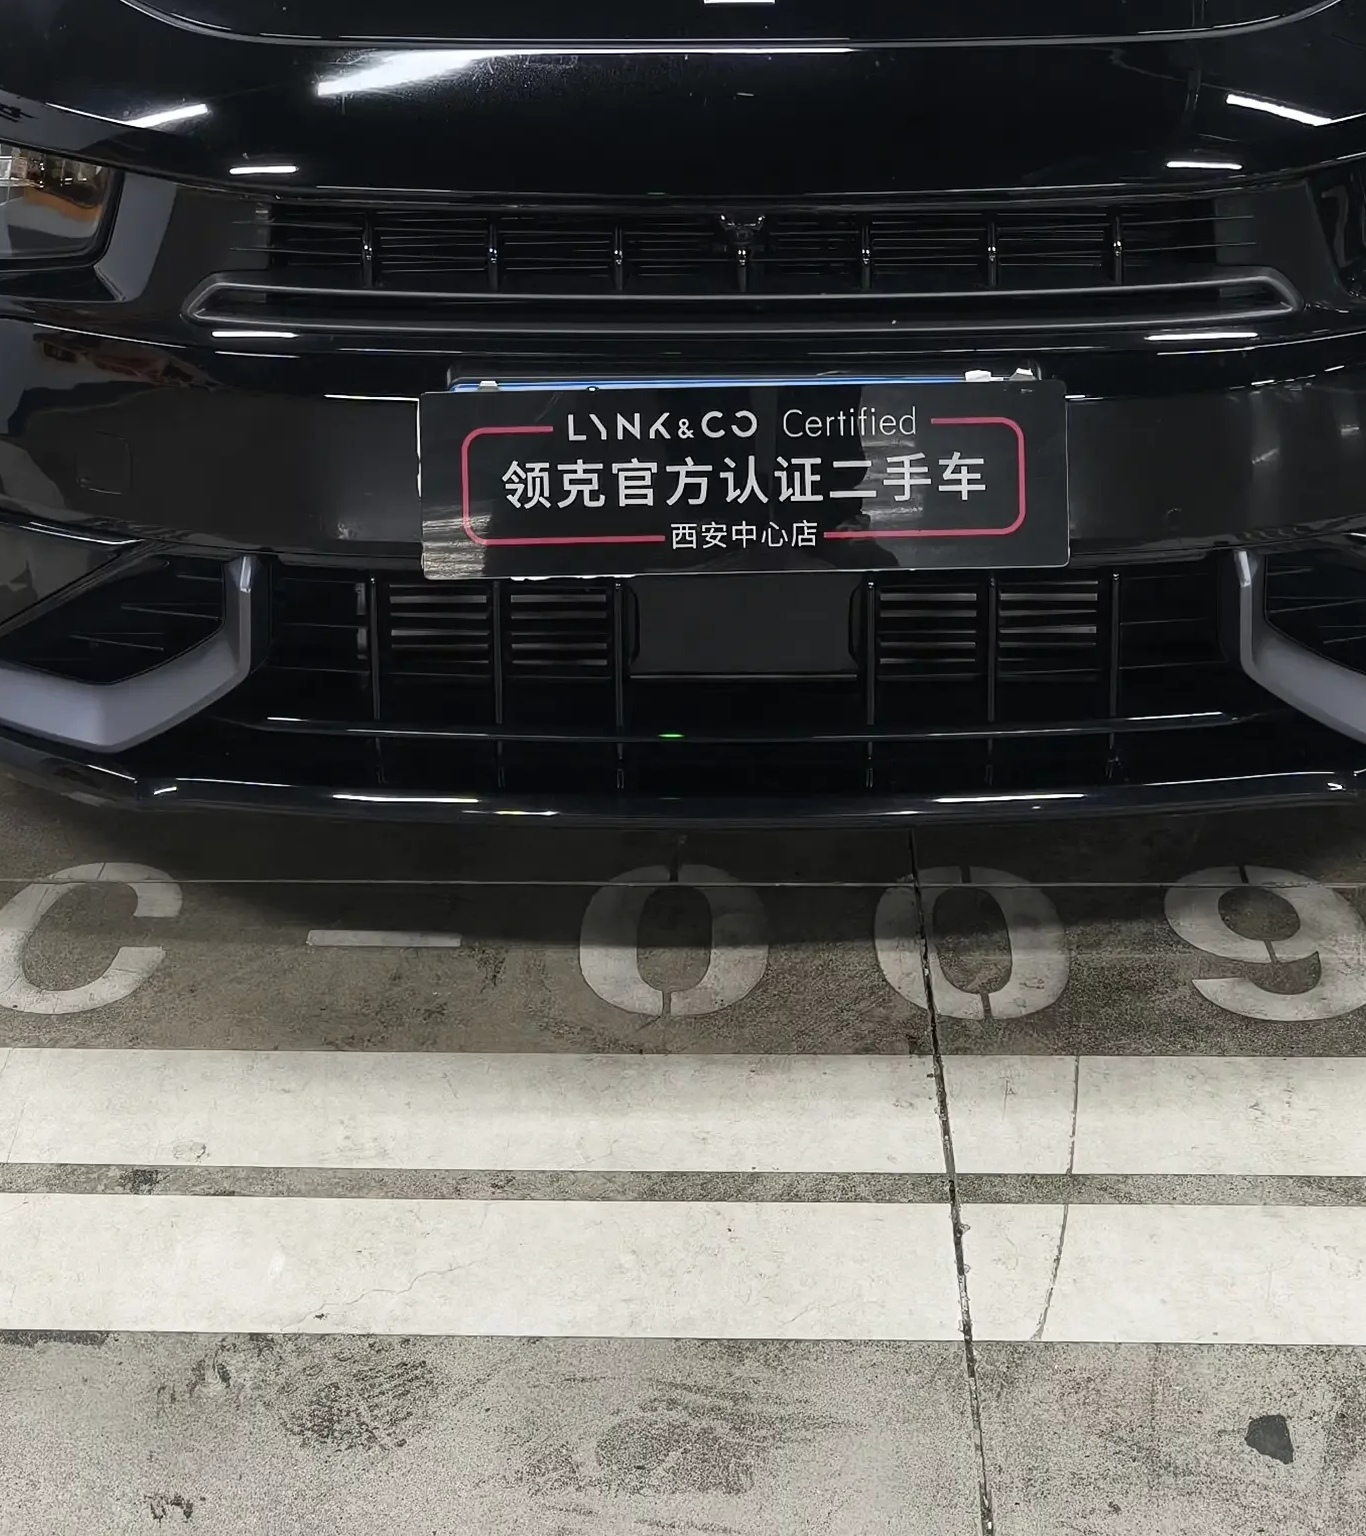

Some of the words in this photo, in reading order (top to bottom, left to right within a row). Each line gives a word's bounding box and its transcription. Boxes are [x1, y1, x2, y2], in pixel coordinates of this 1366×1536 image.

[567, 409, 758, 442] LYNK&CO
[782, 405, 918, 441] Certified
[500, 451, 988, 512] 领克官方认证二手车
[670, 519, 819, 551] 西安中心店
